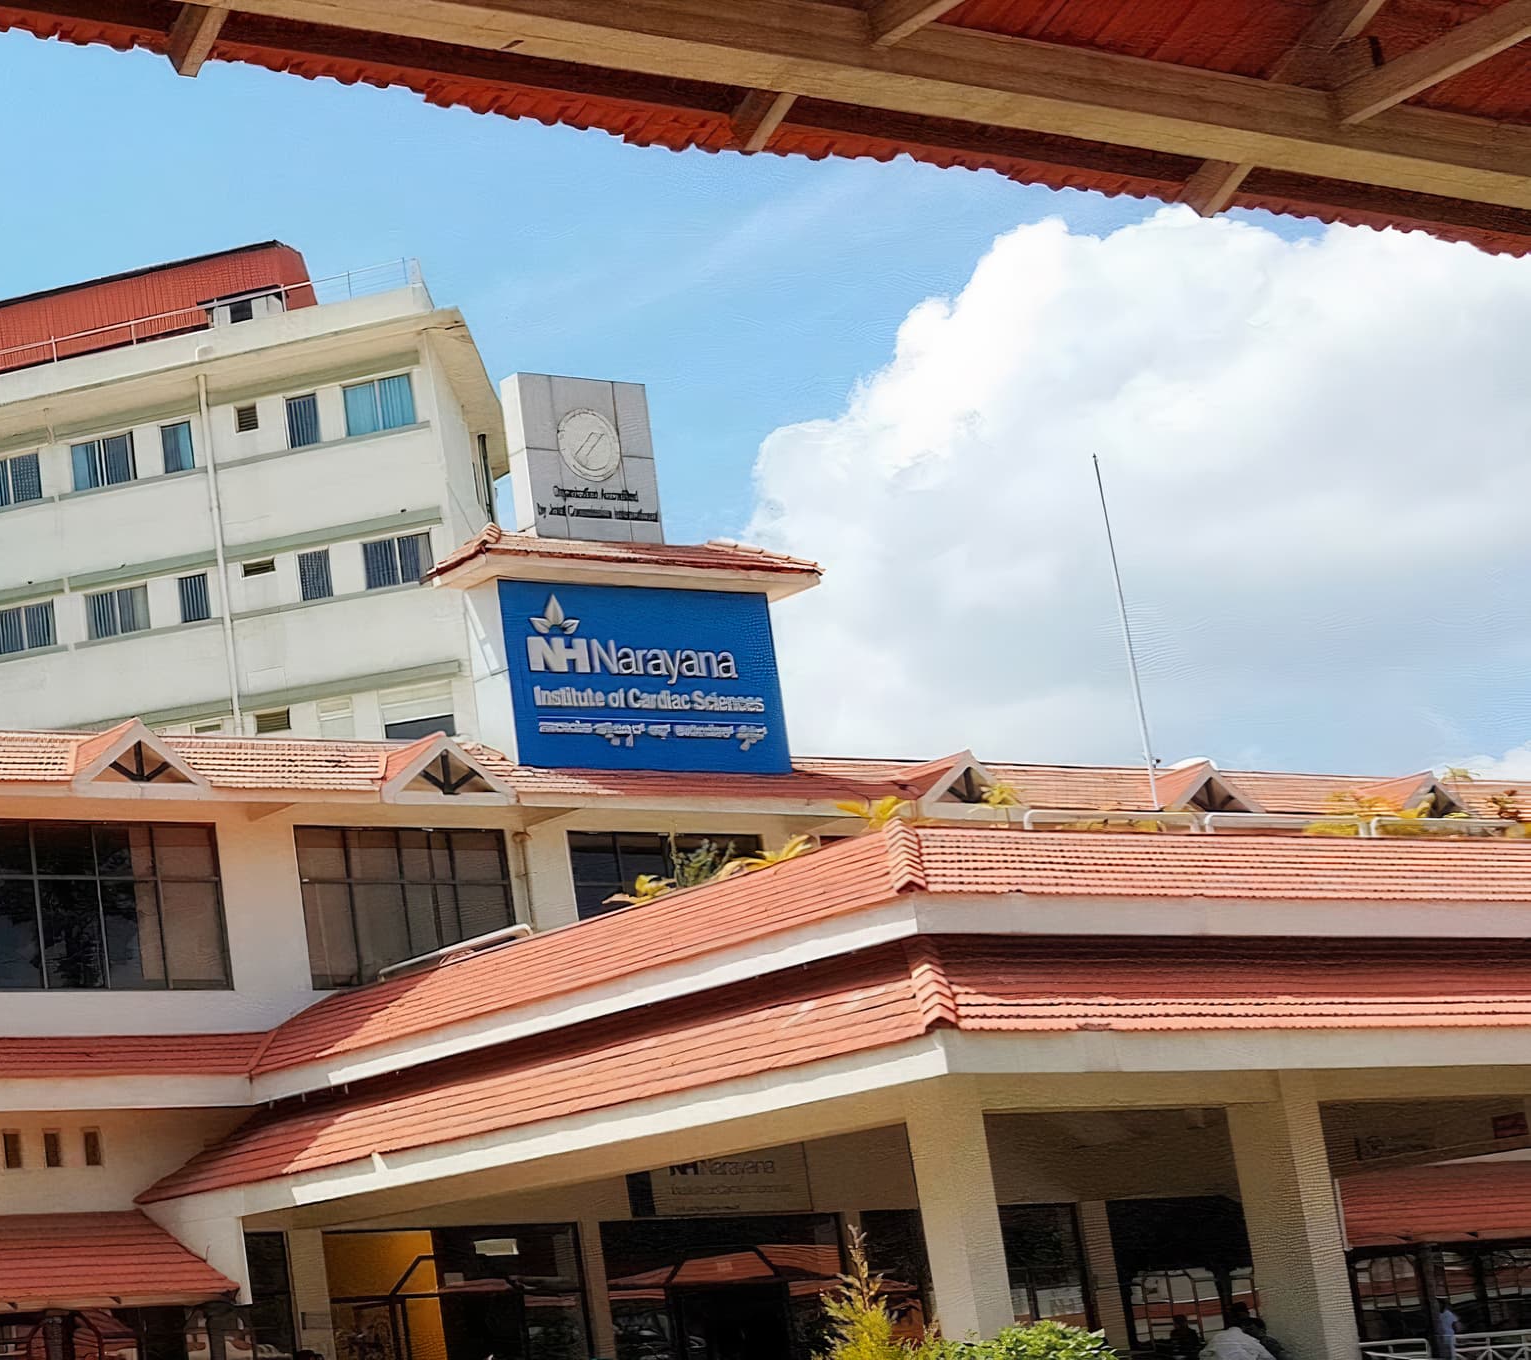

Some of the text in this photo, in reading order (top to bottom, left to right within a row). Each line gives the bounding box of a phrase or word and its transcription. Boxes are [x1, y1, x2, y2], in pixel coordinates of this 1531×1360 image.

[590, 638, 739, 685] Narayana
[533, 685, 766, 713] Institute of Cardiac Sciences
